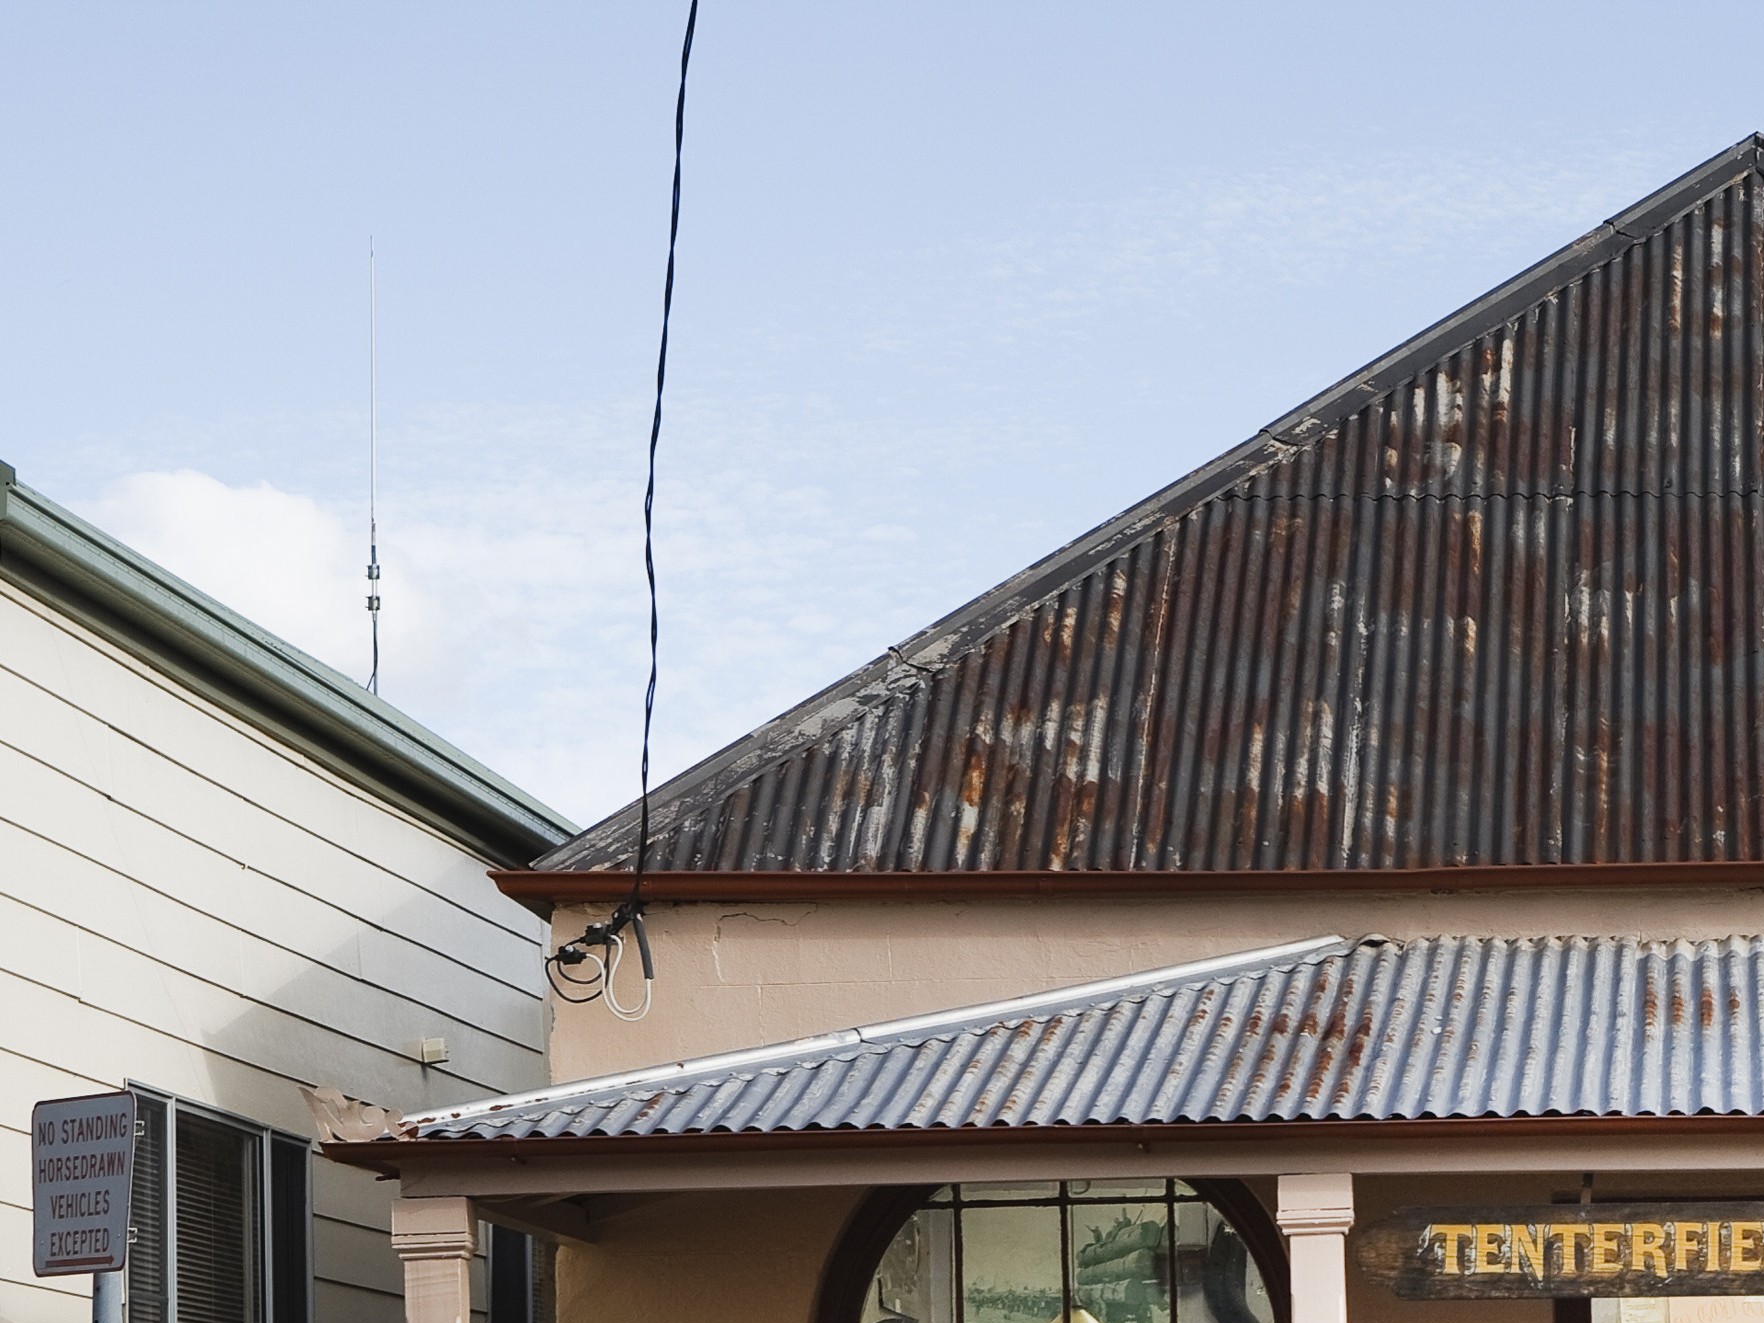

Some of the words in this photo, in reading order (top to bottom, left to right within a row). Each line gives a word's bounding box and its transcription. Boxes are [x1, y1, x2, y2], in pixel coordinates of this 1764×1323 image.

[38, 1121, 56, 1147] NO
[62, 1112, 128, 1145] STANDING
[38, 1151, 126, 1184] HORSEDRAWN
[50, 1189, 110, 1220] VEHICLES
[50, 1227, 110, 1257] EXCEPTED
